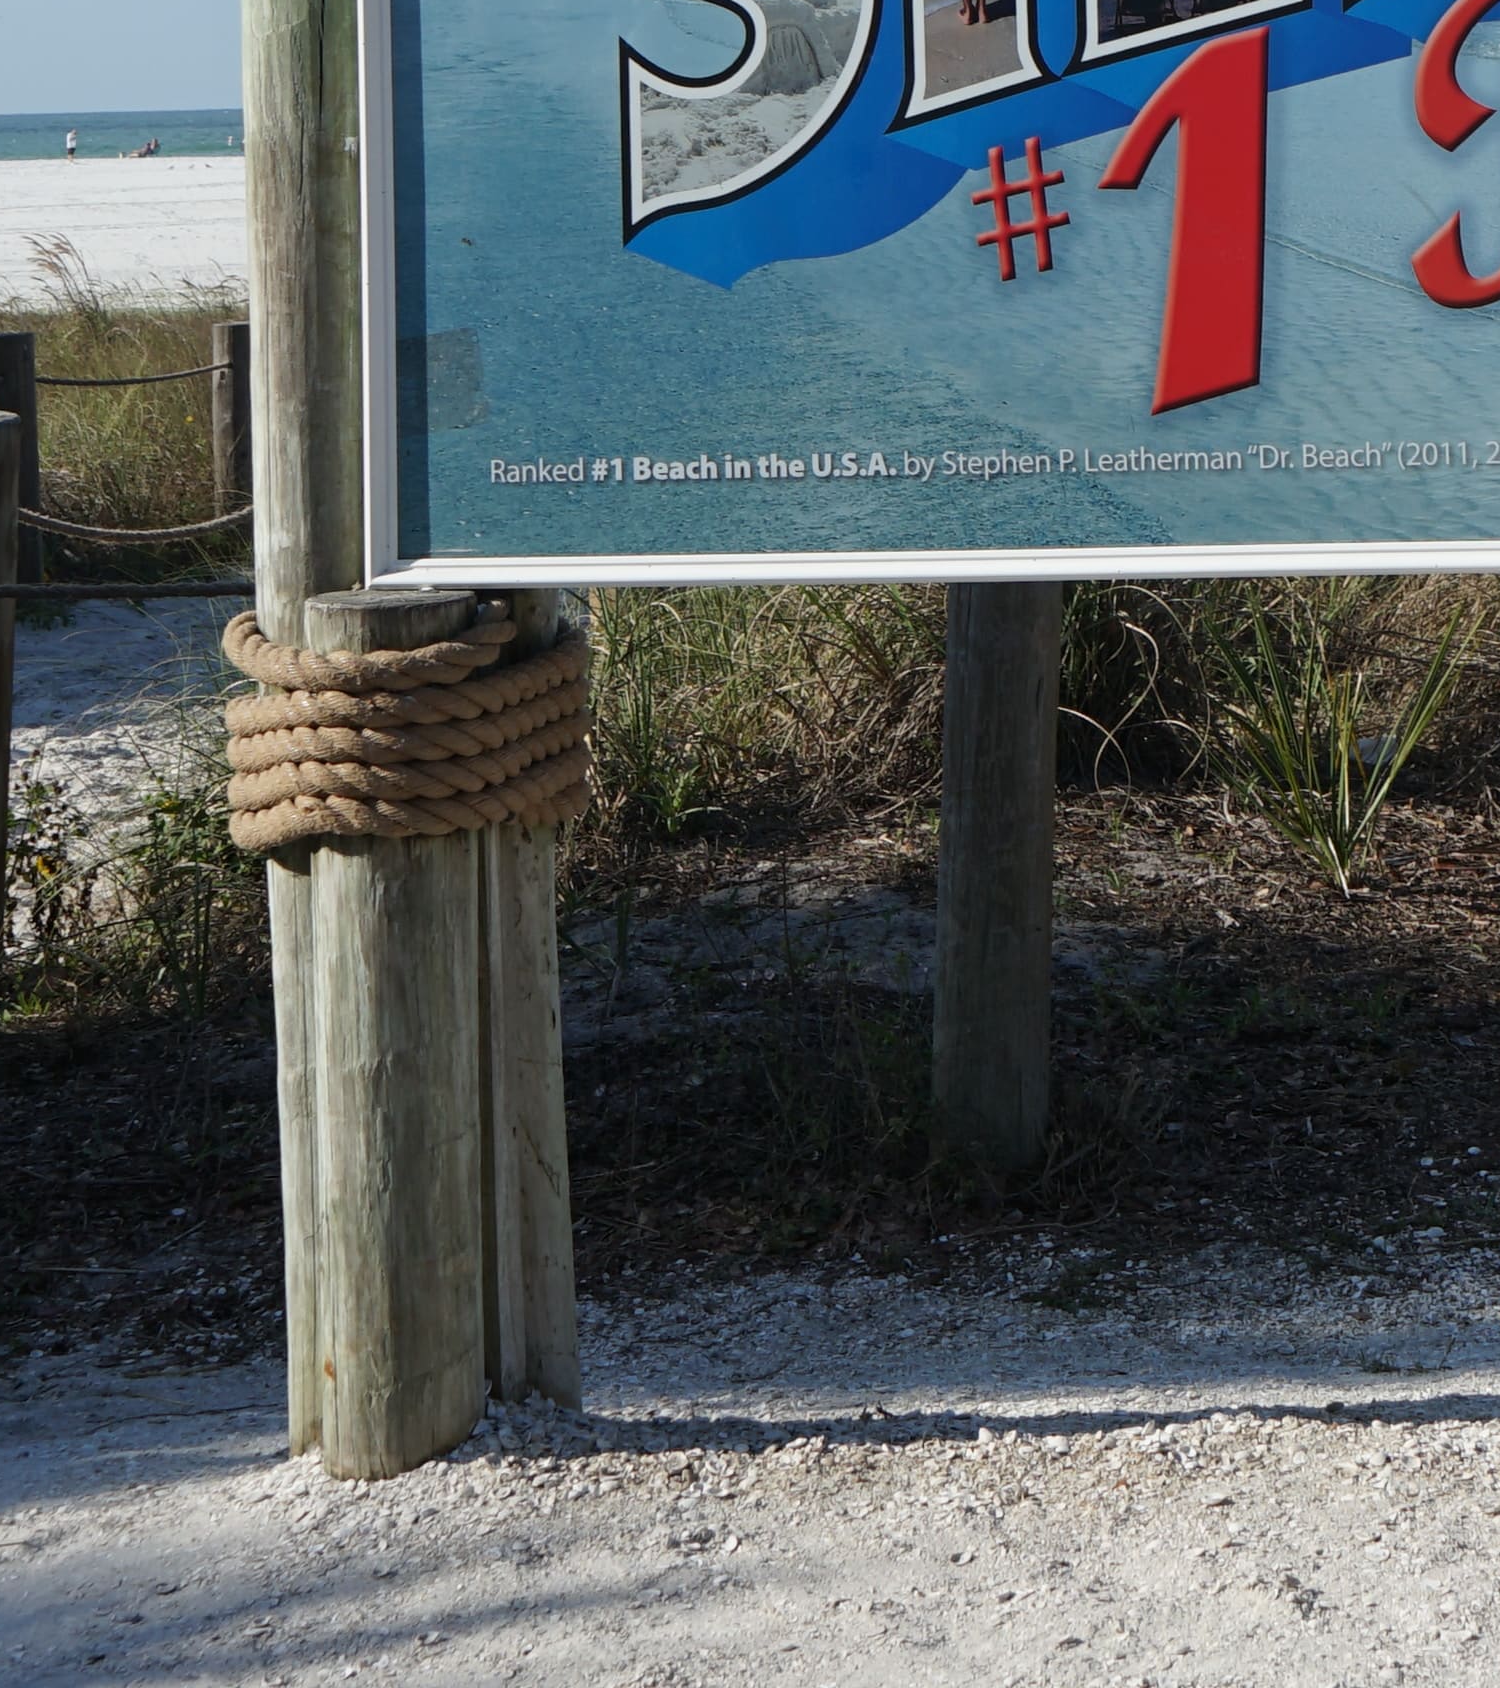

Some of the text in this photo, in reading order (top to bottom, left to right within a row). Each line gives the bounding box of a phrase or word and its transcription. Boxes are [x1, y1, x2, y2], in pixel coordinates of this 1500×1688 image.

[490, 457, 585, 484] Ranked
[591, 458, 623, 481] #1
[632, 455, 718, 481] Beach
[725, 454, 752, 480] in
[758, 453, 805, 478] the
[811, 452, 897, 478] U.S.A.
[904, 451, 936, 482] by
[942, 450, 1052, 481] Stephen
[1060, 449, 1077, 473] P.
[1085, 446, 1242, 472] Leatherman
[1397, 442, 1478, 469] (2011,
